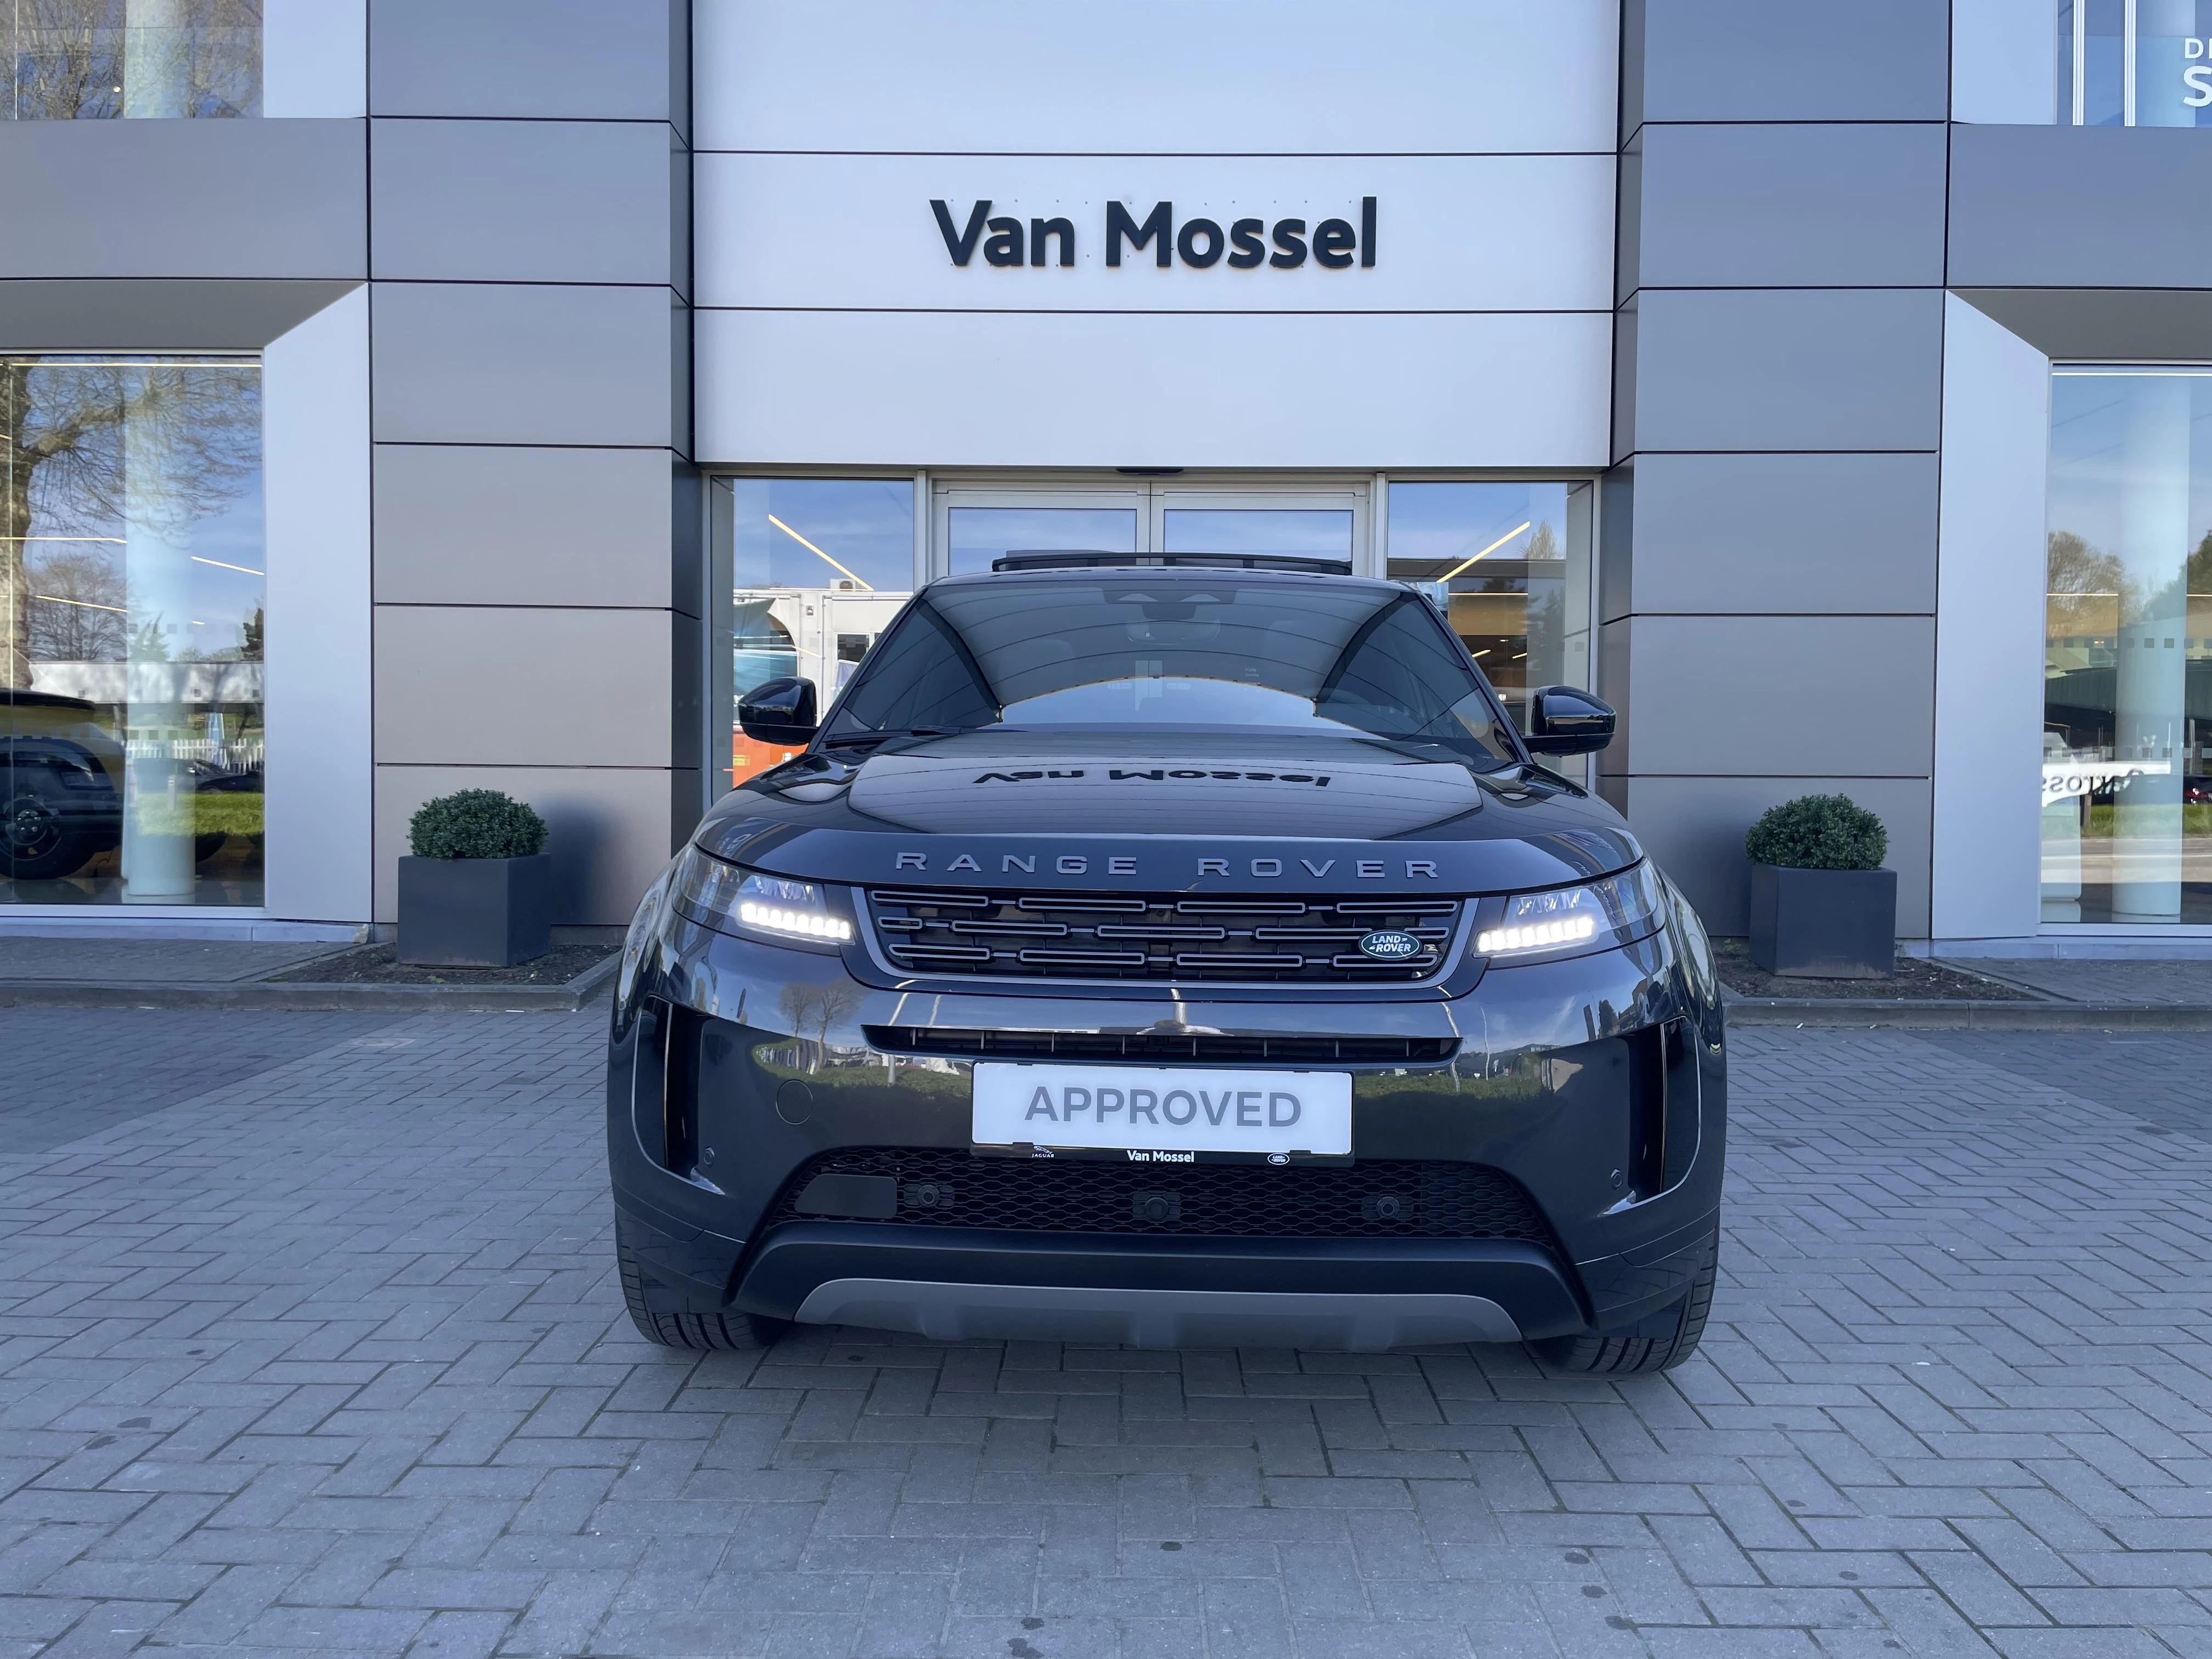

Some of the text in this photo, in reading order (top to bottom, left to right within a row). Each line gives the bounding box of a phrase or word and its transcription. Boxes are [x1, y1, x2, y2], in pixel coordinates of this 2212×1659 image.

[929, 196, 1377, 268] Van Mossel
[895, 852, 1440, 878] RANGE ROVER
[1372, 935, 1401, 944] LAND
[1375, 943, 1412, 952] ROVER
[1024, 1086, 1302, 1127] APPROVED
[1126, 1149, 1195, 1163] Van Mossel
